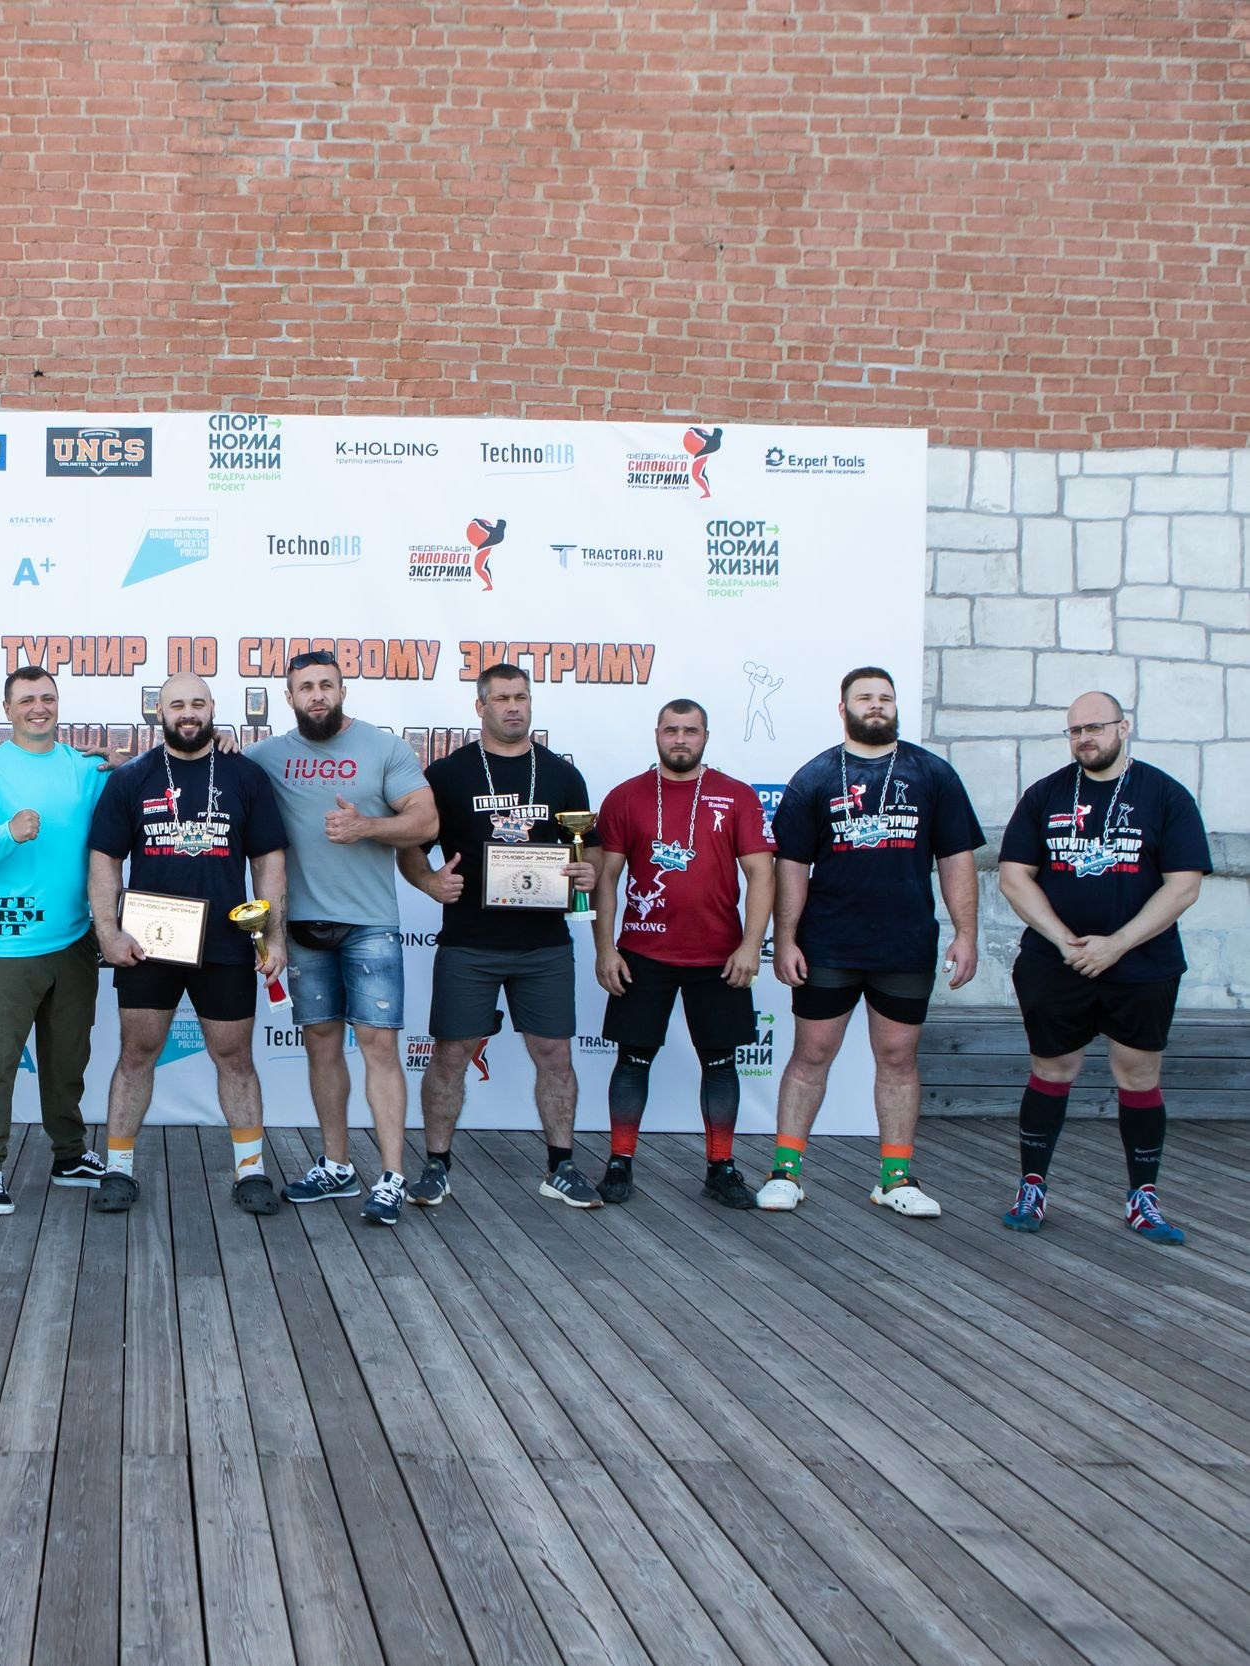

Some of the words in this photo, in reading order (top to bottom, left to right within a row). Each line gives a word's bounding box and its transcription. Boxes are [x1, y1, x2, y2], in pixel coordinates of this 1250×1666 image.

[208, 415, 268, 431] СПОРТ
[208, 433, 281, 450] НОРМА
[53, 438, 145, 461] UNCS
[336, 442, 439, 457] K-HOLDING
[480, 442, 575, 464] TechnoAIR
[626, 452, 689, 460] ФЕДЕРАЦИЯ
[208, 452, 281, 469] ЖИЗНИ
[627, 460, 688, 472] СИЛОВОГО
[789, 455, 827, 469] Expert
[831, 455, 865, 467] Tools
[208, 471, 281, 482] ФЕДЕРАЛЬНЫЙ
[627, 472, 690, 485] ЭКСТРИМА
[208, 483, 246, 491] ПРОЕКТ
[706, 521, 766, 537] СПОРТ
[266, 534, 361, 556] TechnoAIR
[707, 539, 779, 556] НОРМА
[409, 552, 470, 564] СИЛОВОГО
[580, 548, 664, 561] TRACTORI.RU
[408, 565, 472, 578] ЭКСТРИМА
[707, 559, 779, 576] ЖИЗНИ
[707, 578, 779, 588] ФЕДЕРАЛЬНЫЙ
[707, 589, 744, 597] ПРОЕКТ
[1, 635, 147, 677] ТУРНИР
[167, 635, 218, 677] ПО
[284, 758, 357, 779] HUGO
[889, 815, 919, 828] УРНИР
[521, 875, 533, 890] 3
[155, 926, 163, 941] 1
[736, 1048, 772, 1065] ЗНИ
